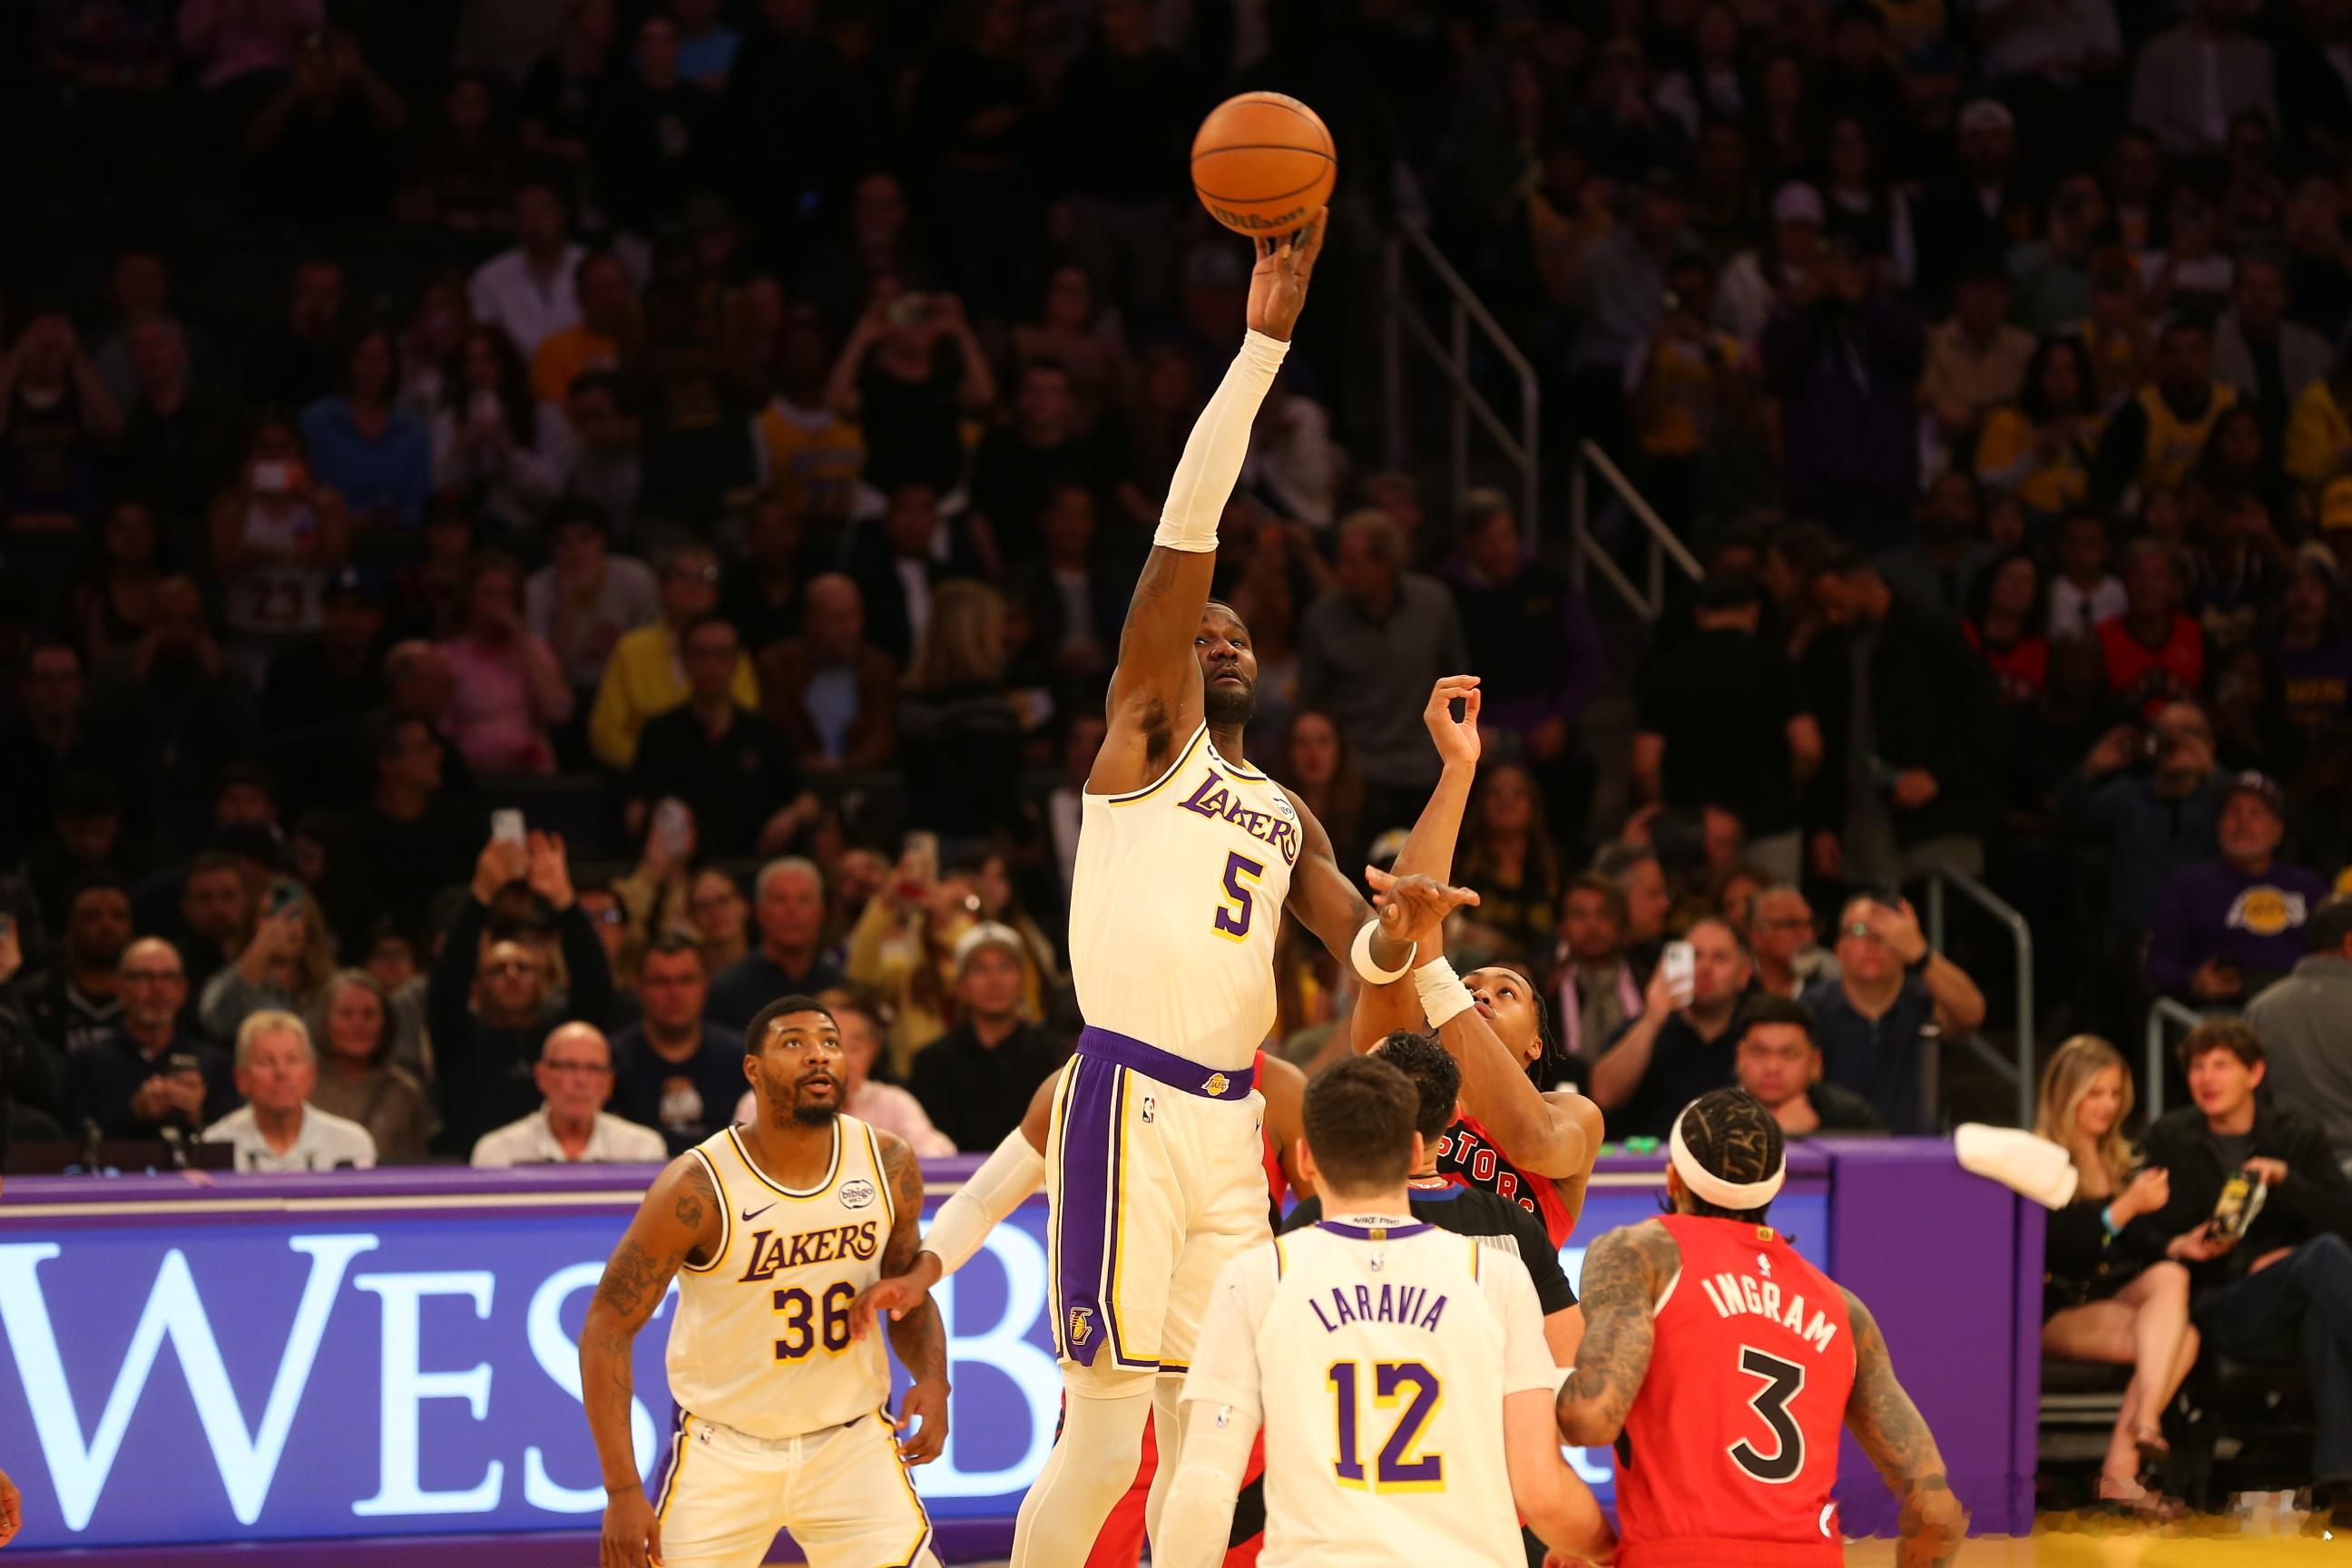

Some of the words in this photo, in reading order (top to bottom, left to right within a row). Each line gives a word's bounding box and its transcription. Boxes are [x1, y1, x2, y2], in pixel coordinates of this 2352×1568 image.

[1212, 205, 1307, 230] Wilson
[1177, 768, 1298, 867] LAKERS
[1211, 849, 1265, 945] 5
[739, 1220, 878, 1283] LAKERS
[773, 1280, 857, 1363] 36
[1308, 1284, 1448, 1332] LARAVIA
[1700, 1272, 1838, 1353] INGRAM
[1325, 1359, 1446, 1494] 12
[1727, 1343, 1806, 1485] 3
